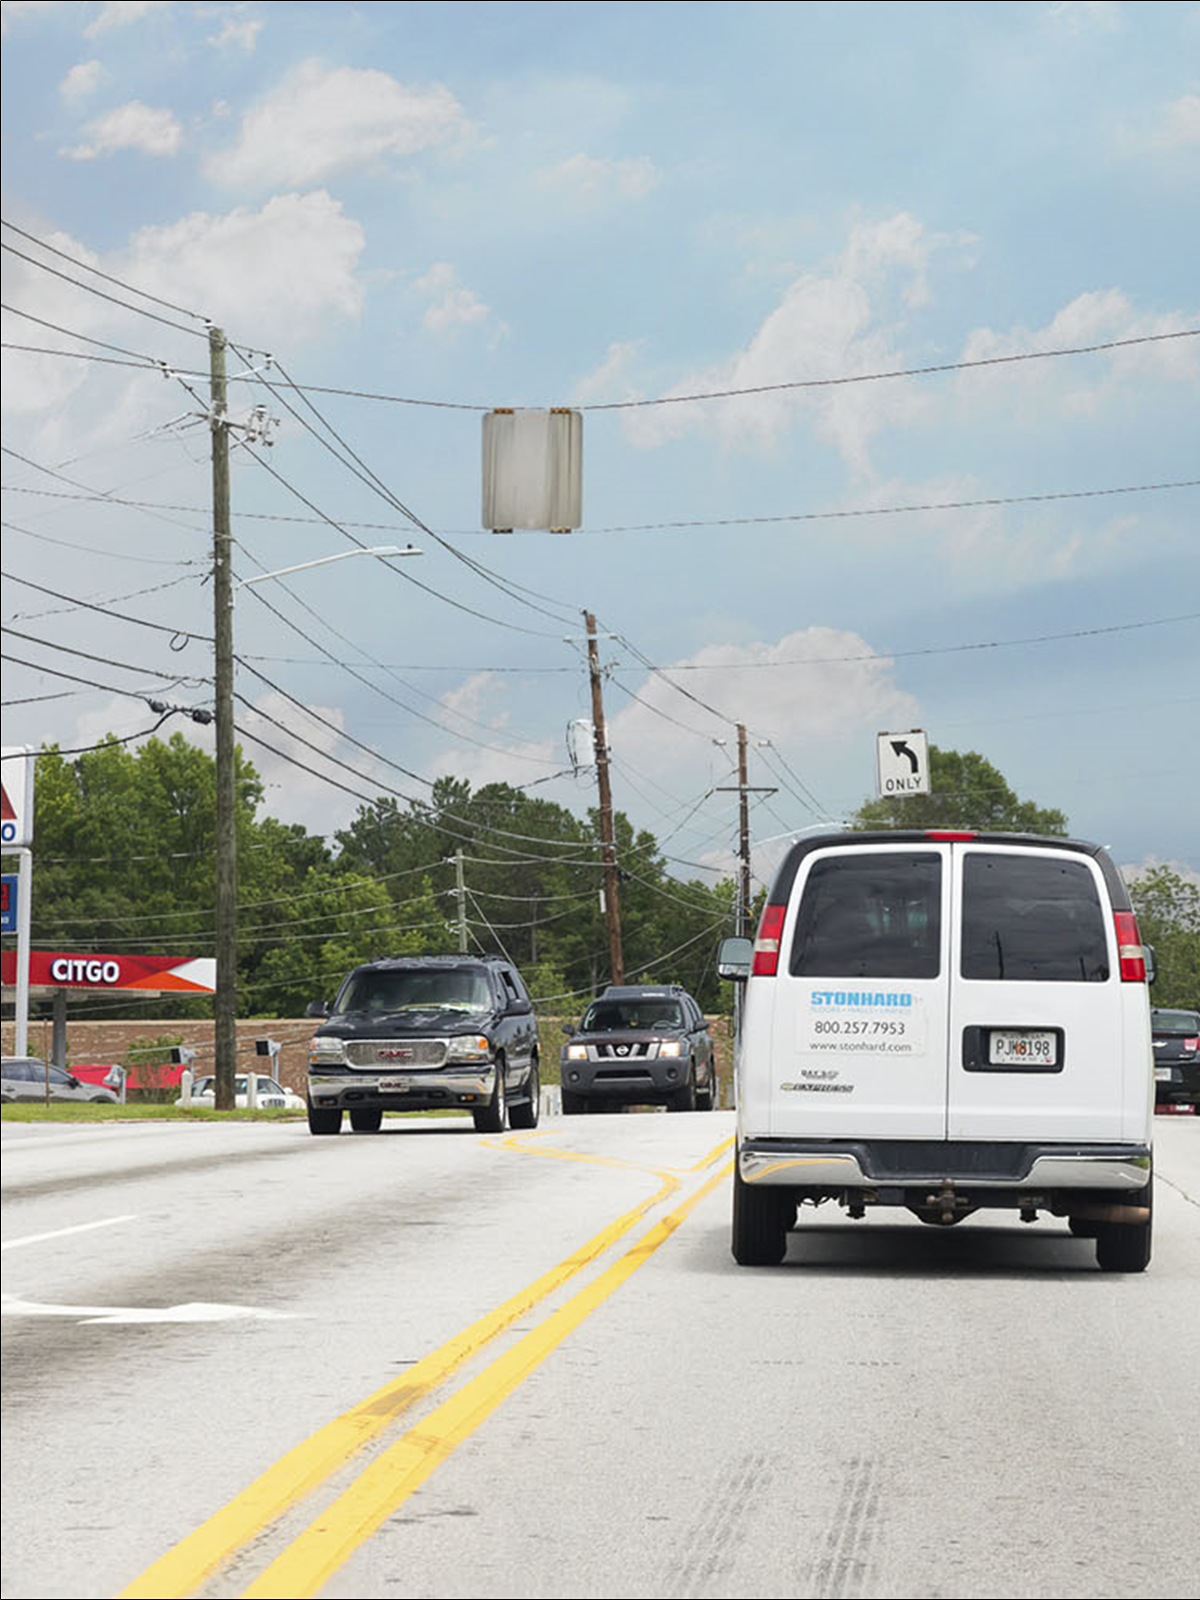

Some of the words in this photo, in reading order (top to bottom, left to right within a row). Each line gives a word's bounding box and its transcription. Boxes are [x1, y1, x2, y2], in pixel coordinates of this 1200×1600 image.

[885, 776, 922, 792] ONLY
[51, 958, 120, 983] CITGO
[810, 991, 912, 1007] STONHARD
[814, 1020, 906, 1036] 800.257.7953
[809, 1041, 912, 1052] www.stonhard.com
